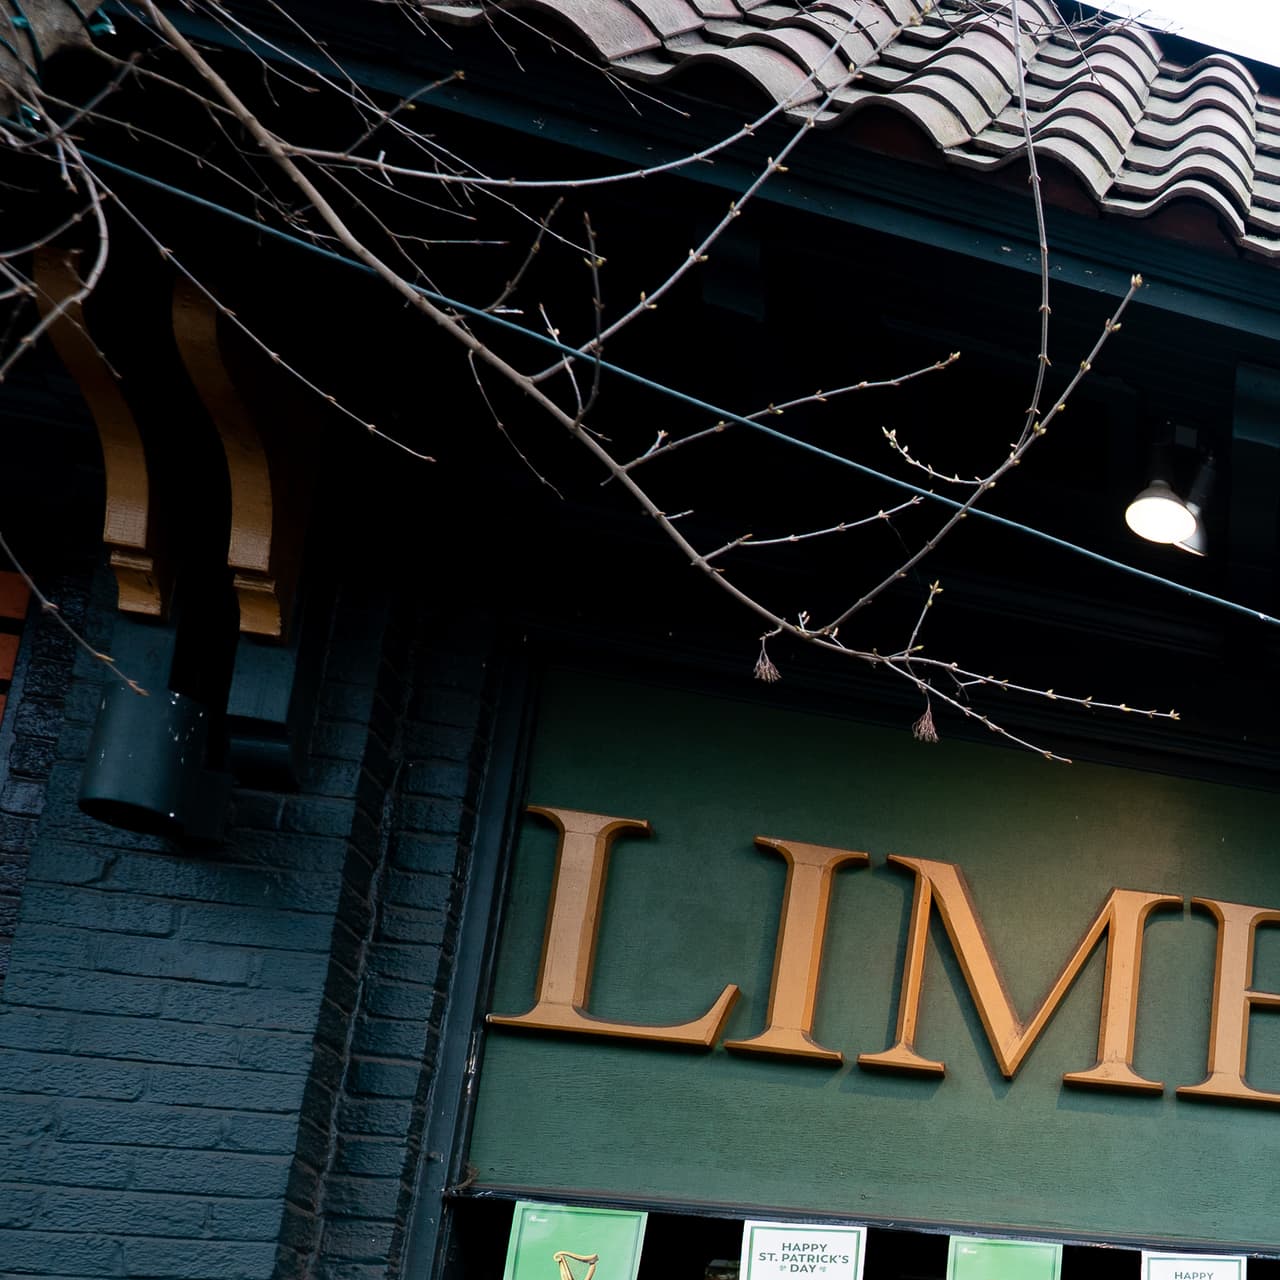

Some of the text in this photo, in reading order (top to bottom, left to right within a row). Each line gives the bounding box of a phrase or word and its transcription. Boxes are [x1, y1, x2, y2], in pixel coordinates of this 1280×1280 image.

[782, 1243, 827, 1252] HAPPY
[759, 1253, 849, 1264] ST. PATRICK'S
[1175, 1272, 1213, 1280] HAPPY
